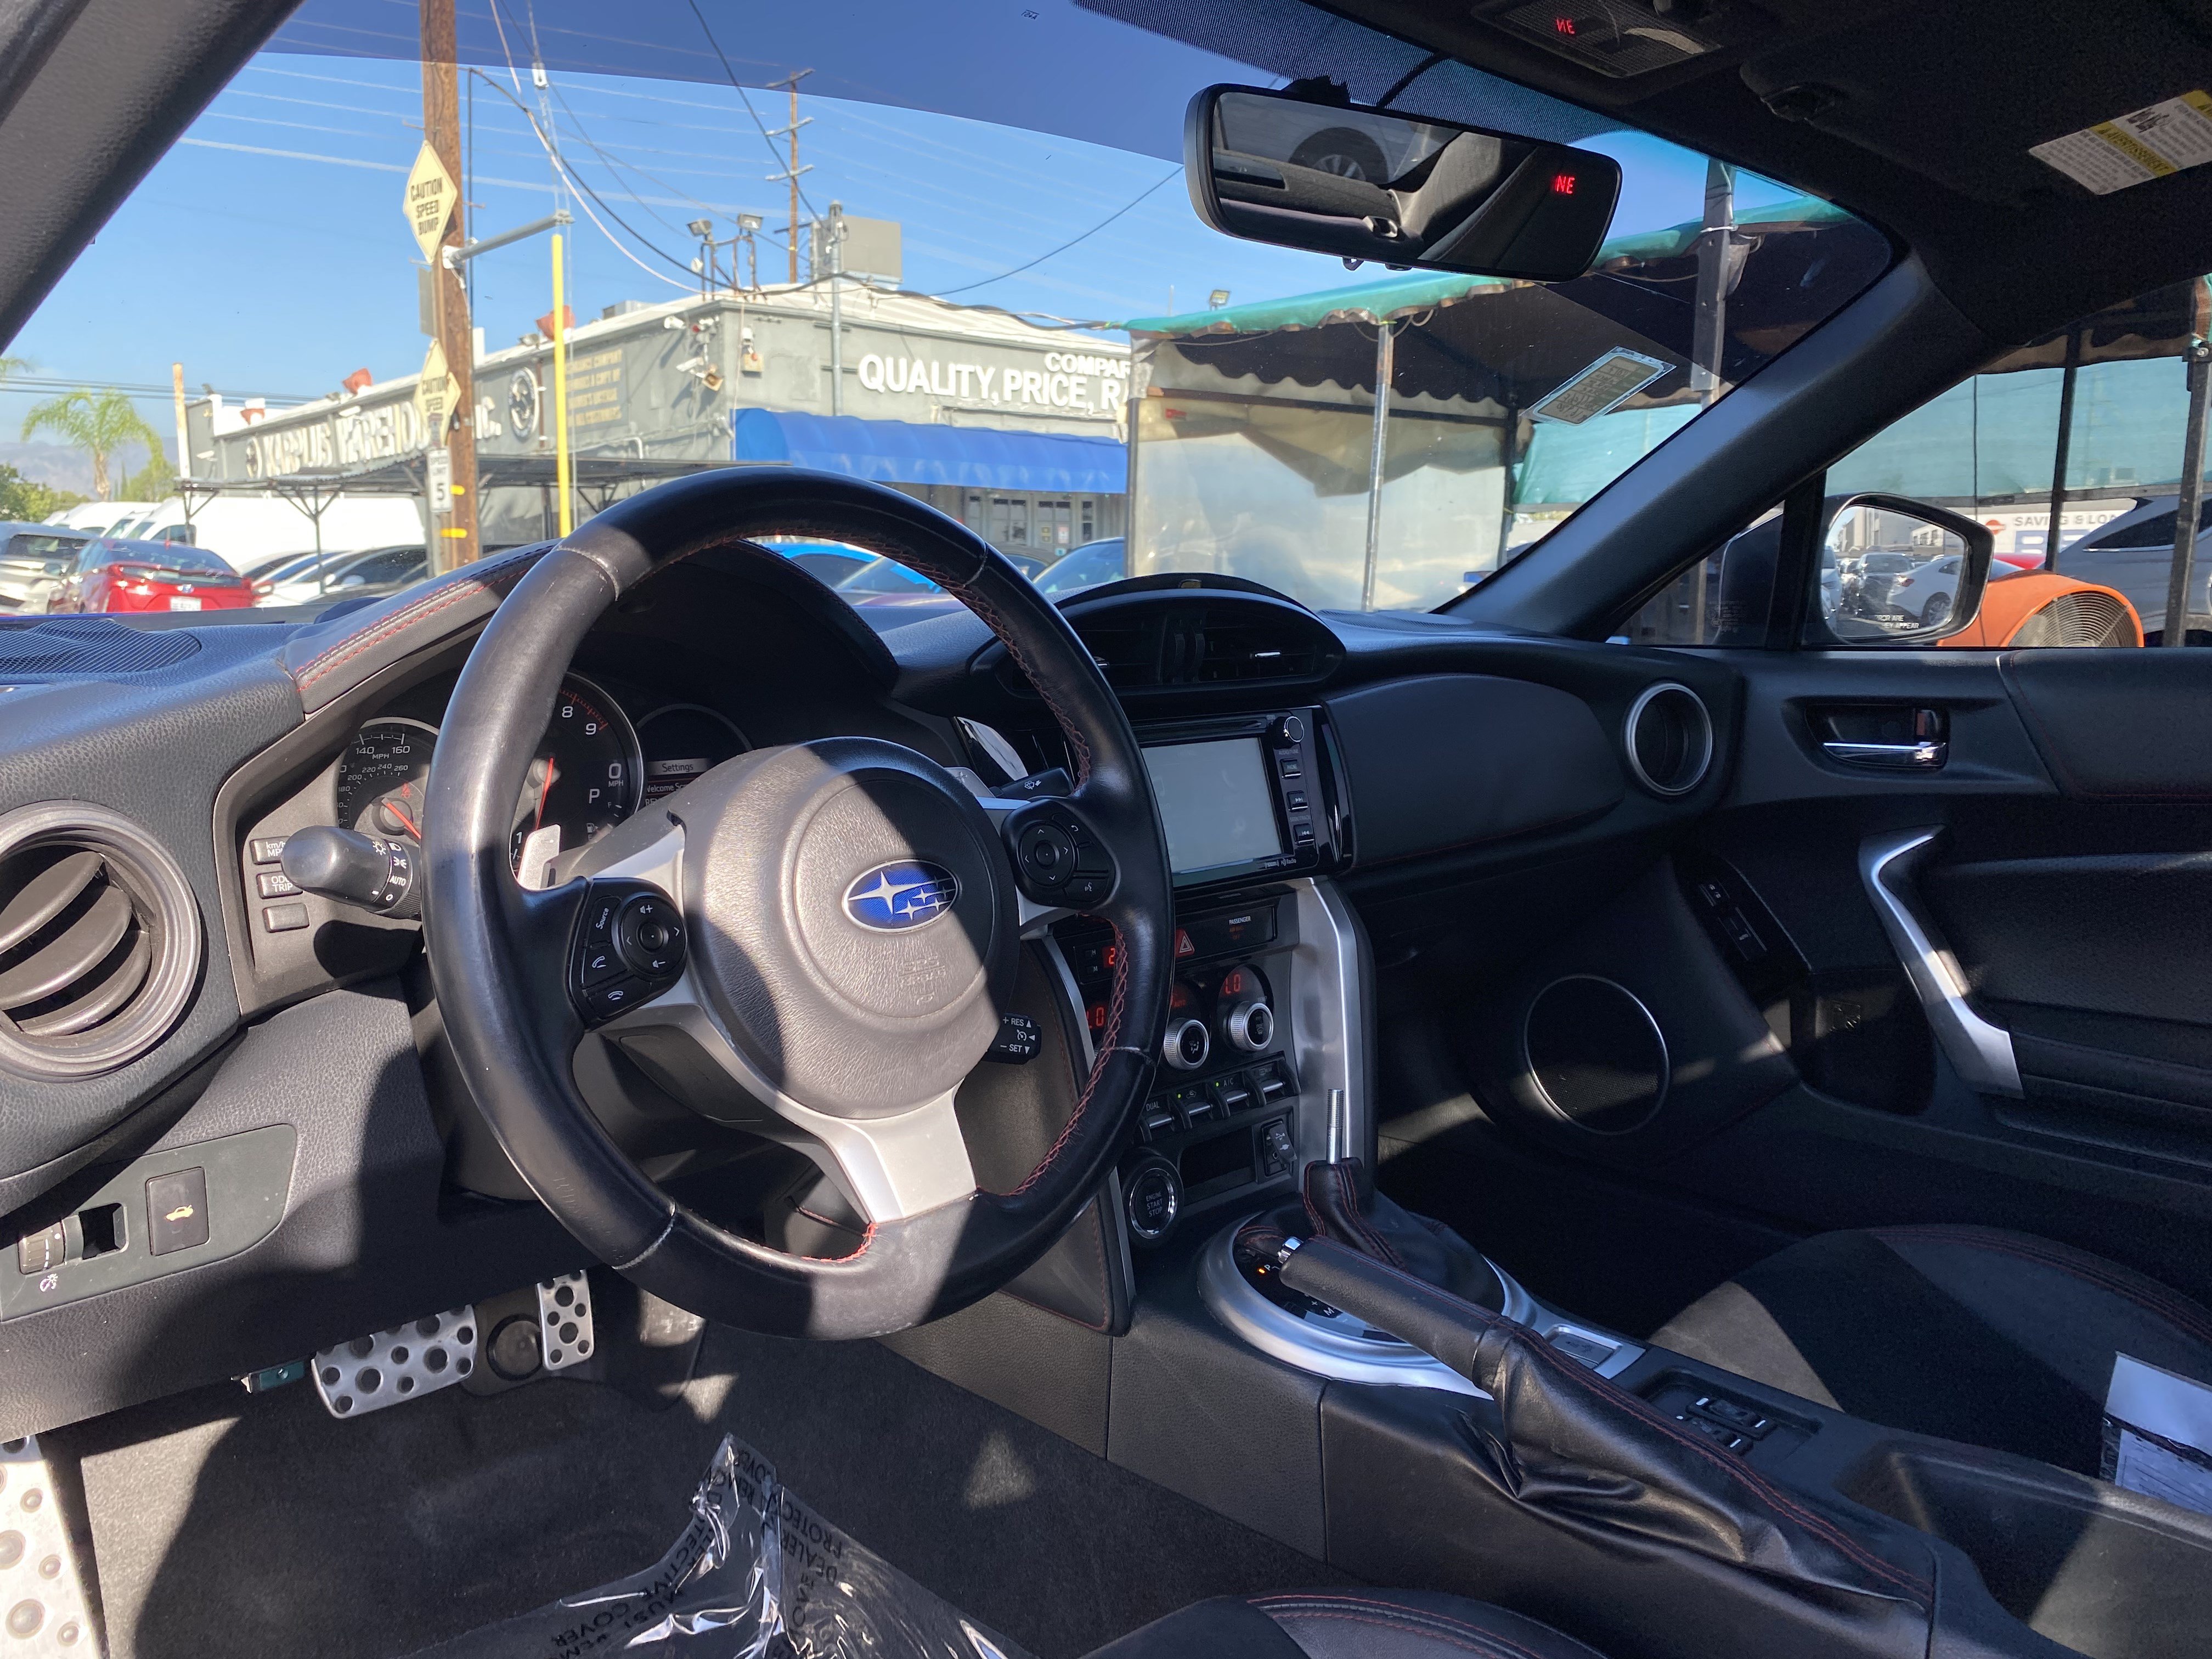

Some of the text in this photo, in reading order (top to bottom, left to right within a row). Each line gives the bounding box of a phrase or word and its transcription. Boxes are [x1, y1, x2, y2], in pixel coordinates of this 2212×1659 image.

[410, 177, 443, 202] CAUTION
[1554, 175, 1575, 195] NE
[416, 200, 439, 218] SPEED
[417, 217, 439, 236] BUMP
[422, 377, 447, 395] CAUTION
[858, 354, 1129, 414] QUALITY, PRICE, R
[425, 397, 443, 412] SPEED
[430, 456, 448, 466] SPEED
[436, 483, 445, 501] 5
[2015, 516, 2067, 527] SAVIG
[562, 706, 573, 718] 8
[585, 723, 596, 735] 9
[356, 747, 375, 755] 140
[392, 746, 410, 754] 160
[662, 763, 693, 772] Settings
[589, 788, 600, 804] P
[516, 832, 523, 844] 1
[390, 875, 407, 887] AUTO
[273, 883, 293, 893] TRIP
[596, 908, 609, 929] Source
[1229, 916, 1251, 925] PASSENGER
[1011, 1018, 1024, 1026] RES
[1009, 1043, 1022, 1052] SET
[1223, 1077, 1234, 1087] A/C
[1146, 1101, 1160, 1111] DUAL
[1146, 1190, 1161, 1201] ENGINE
[1147, 1198, 1163, 1210] START
[1149, 1206, 1163, 1217] STOP
[1323, 1307, 1335, 1316] M
[551, 1602, 629, 1647] COVER
